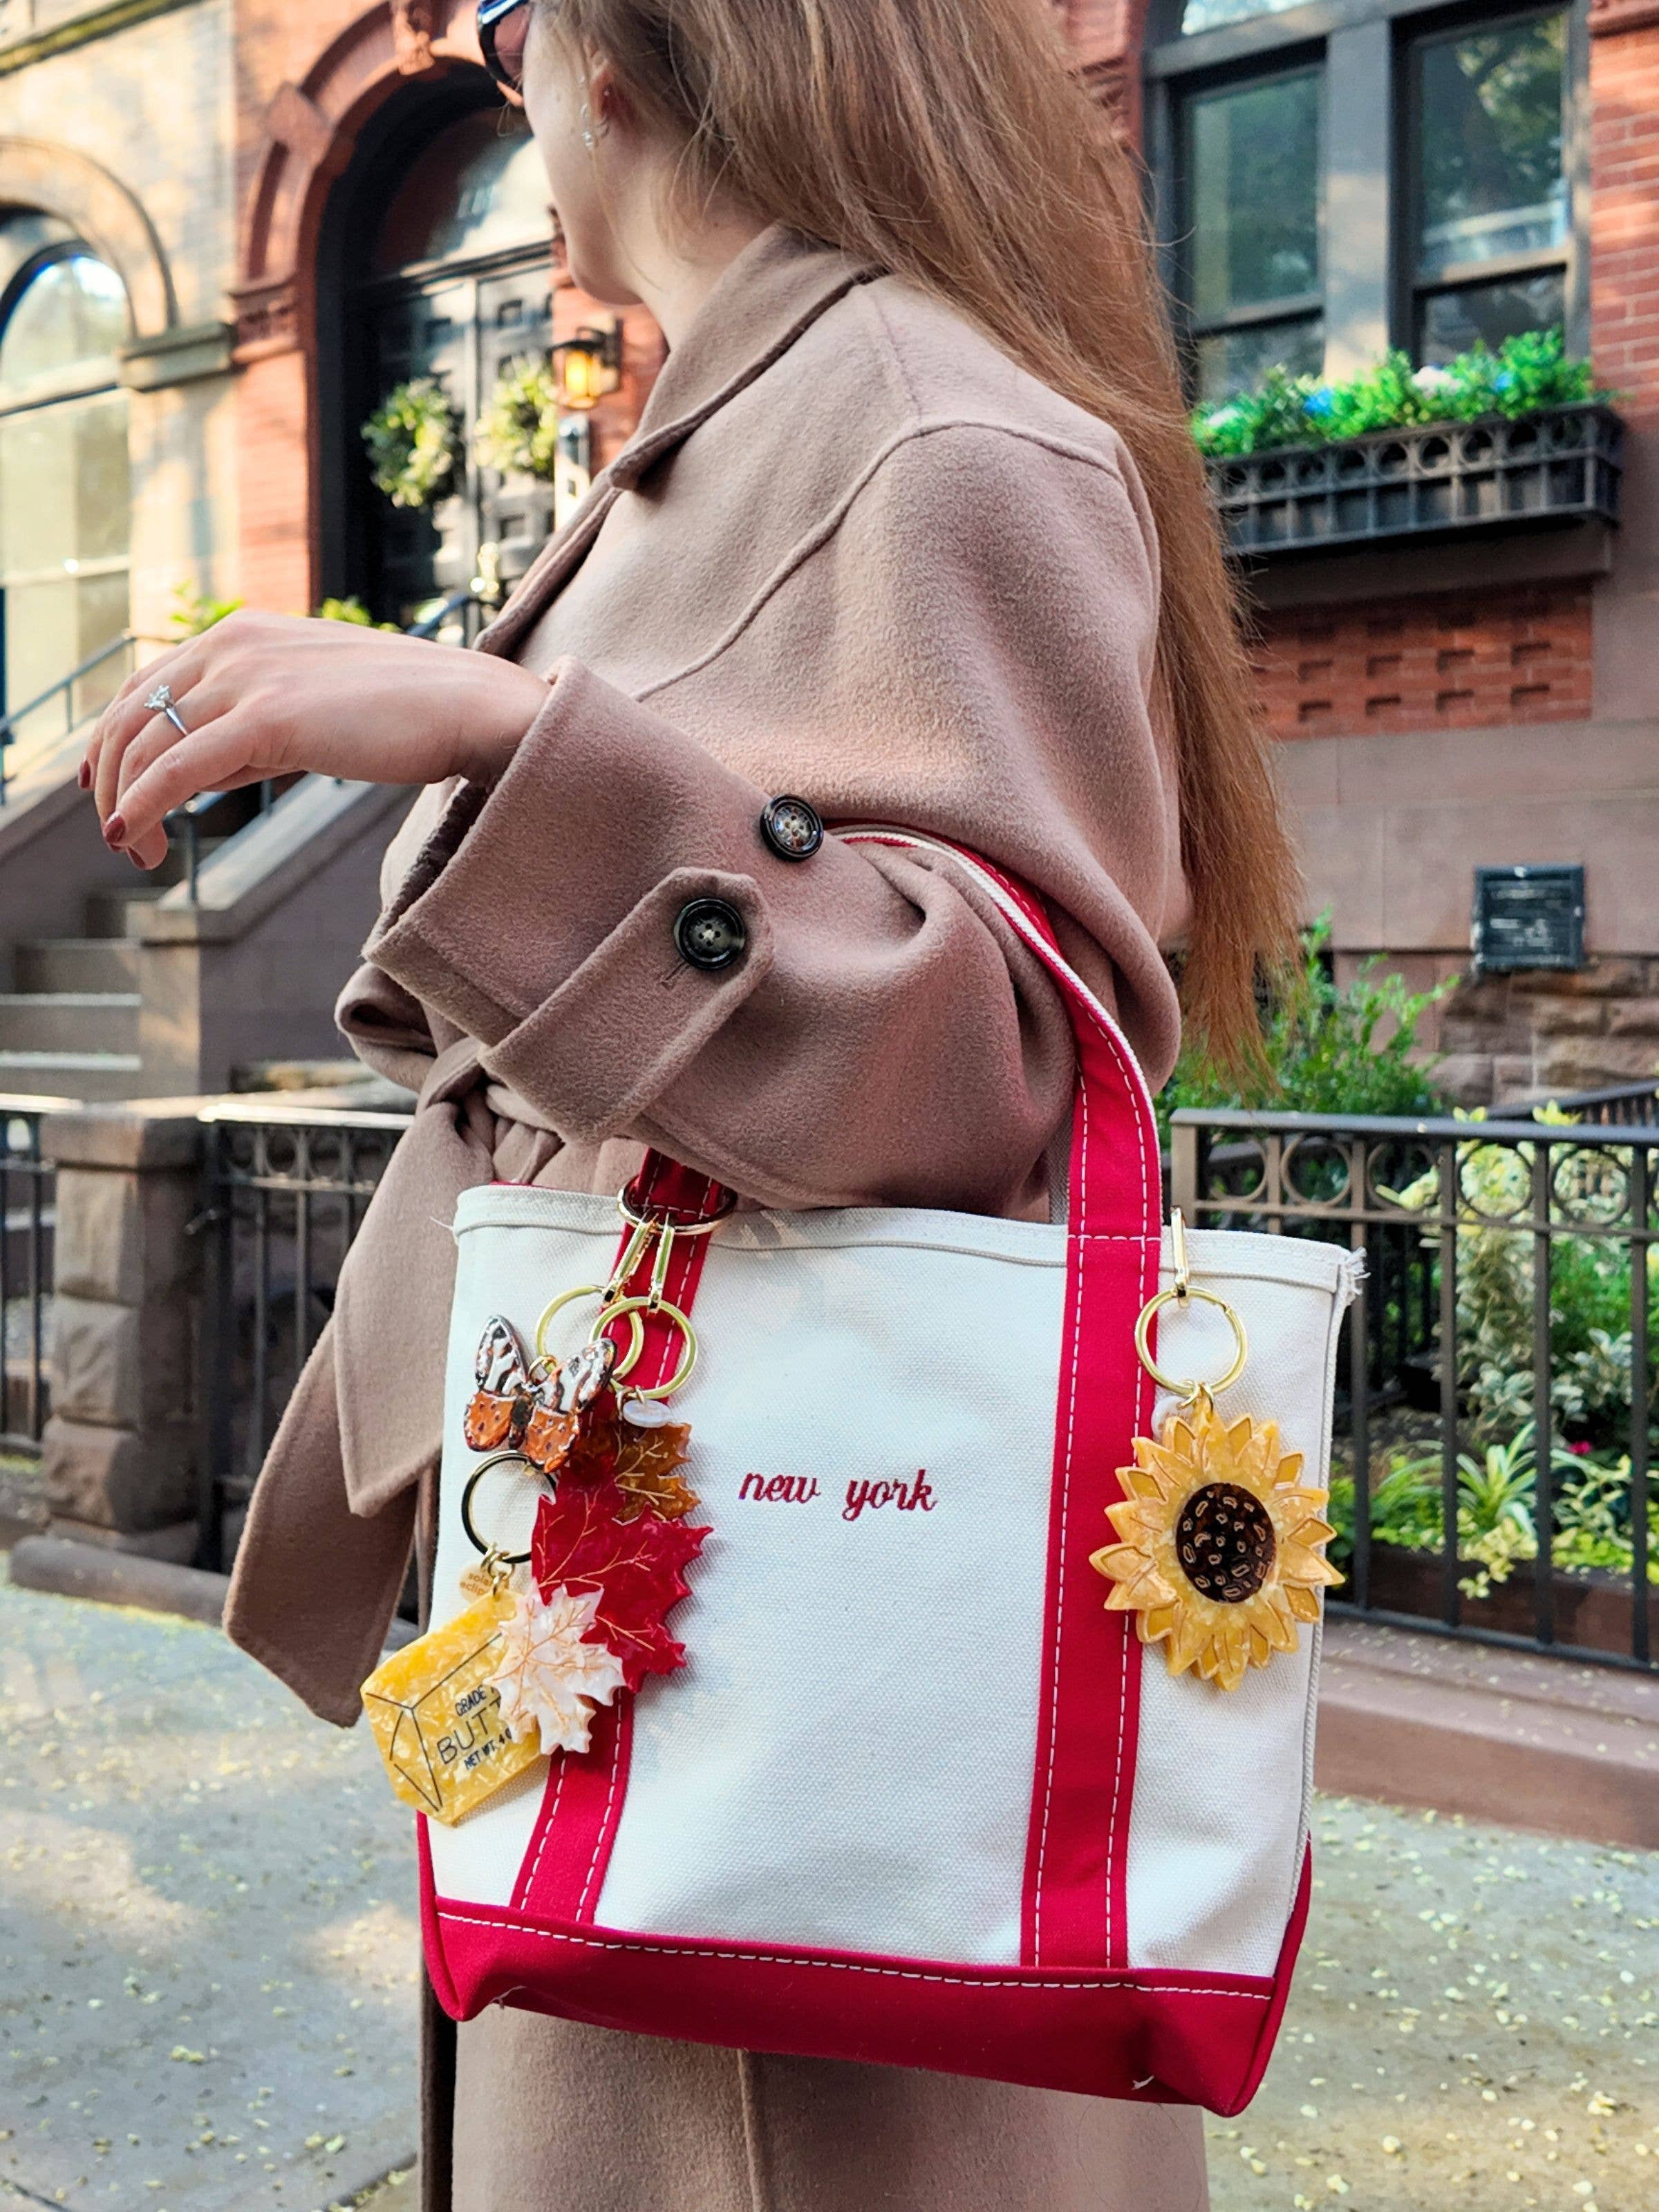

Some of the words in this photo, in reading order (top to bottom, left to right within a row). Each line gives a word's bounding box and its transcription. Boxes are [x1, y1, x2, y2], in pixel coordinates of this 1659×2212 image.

[738, 1472, 821, 1503] new
[842, 1469, 937, 1521] york
[460, 1581, 486, 1596] eclip
[455, 1685, 487, 1716] GRADE
[437, 1696, 501, 1764] BUTT
[464, 1750, 480, 1770] NET
